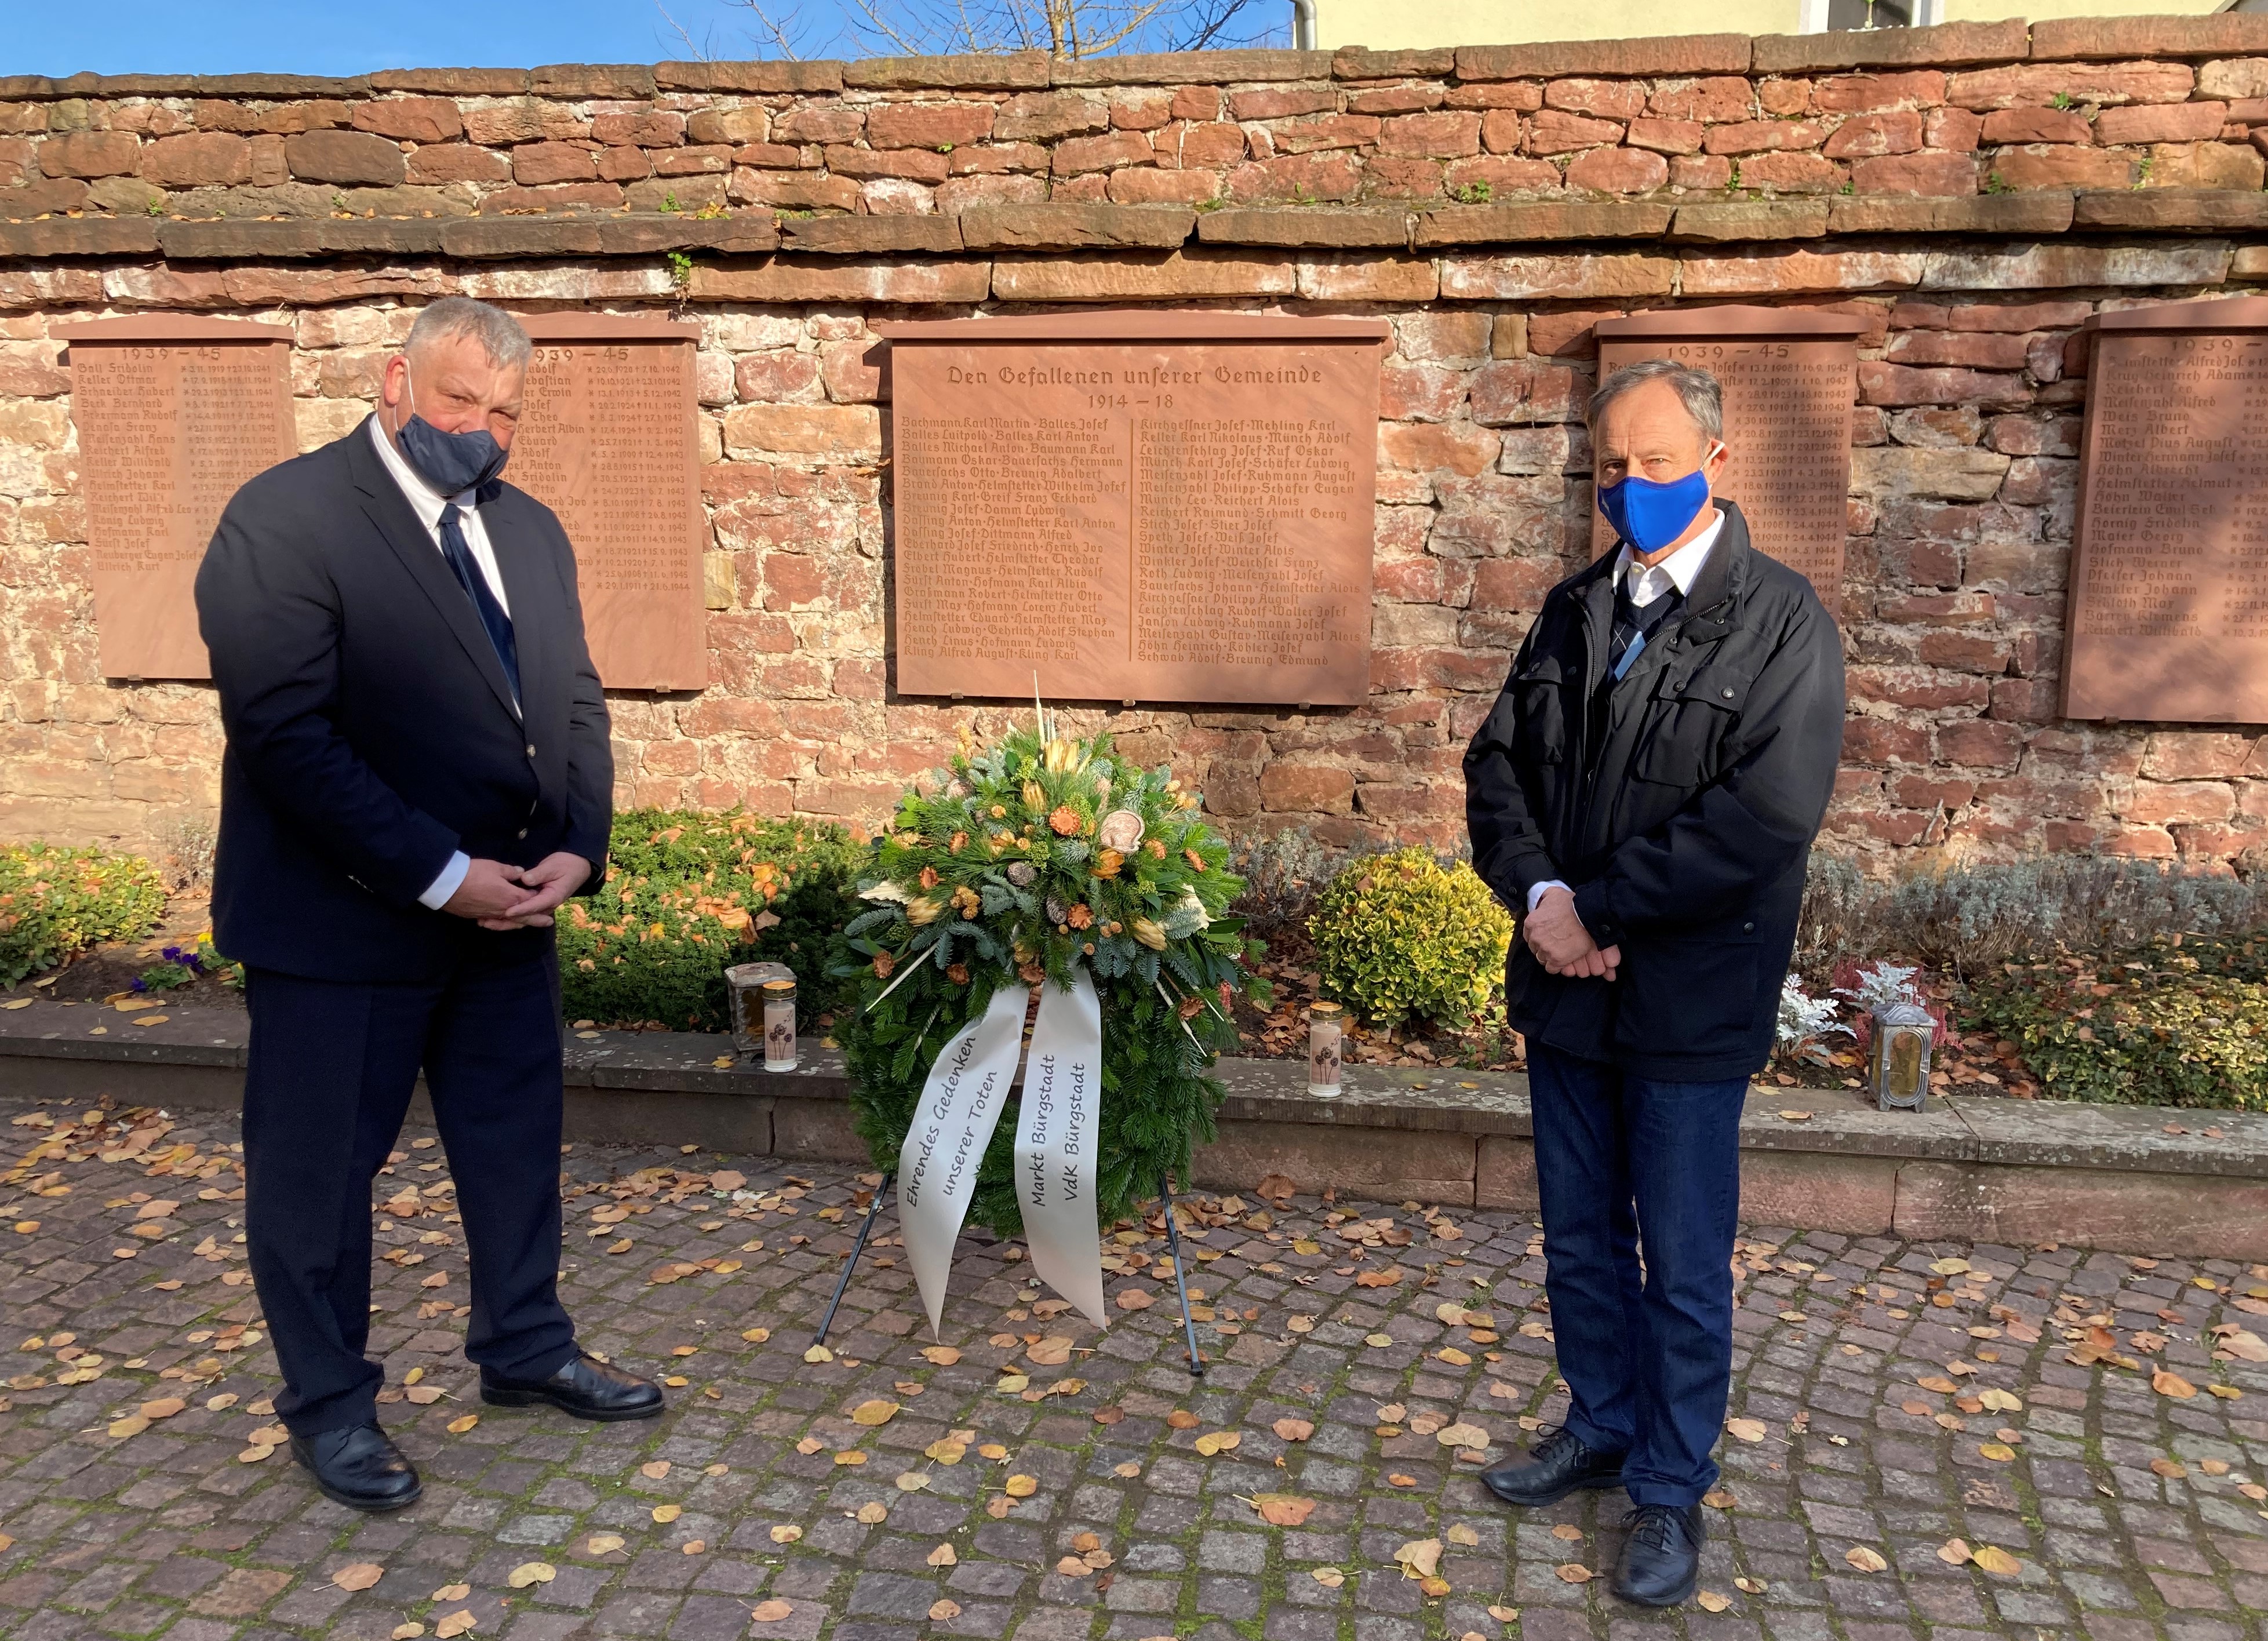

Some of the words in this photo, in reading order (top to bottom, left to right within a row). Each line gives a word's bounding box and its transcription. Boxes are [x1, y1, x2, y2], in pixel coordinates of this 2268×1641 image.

[122, 348, 169, 360] 1939
[198, 347, 221, 360] 45
[536, 349, 574, 362] 939
[603, 347, 629, 361] 45
[1668, 346, 1723, 358] 1939
[1759, 344, 1789, 358] 45
[78, 363, 102, 373] Gall
[526, 363, 556, 374] udolf
[2207, 369, 2245, 380] Adam
[78, 375, 110, 385] Keller
[117, 374, 156, 384] Ottmar
[946, 365, 987, 385] Den
[998, 366, 1113, 388] Gefallenen
[1215, 365, 1322, 384] Gemeinde
[138, 387, 174, 397] Hubert
[540, 387, 571, 396] Erwin
[113, 398, 162, 409] Bernhard
[1089, 394, 1128, 409] 1914
[1156, 394, 1173, 408] 18
[530, 411, 558, 423] Theo
[963, 417, 987, 428] Karl
[990, 417, 1029, 428] Martin
[558, 424, 584, 434] Albin
[1251, 420, 1304, 433] Mehling
[1308, 420, 1335, 431] Karl
[2146, 424, 2189, 435] Albert
[519, 435, 557, 446] Eduard
[902, 429, 939, 440] Balles
[942, 430, 987, 442] Luitpold
[996, 430, 1033, 441] Balles
[1037, 431, 1061, 441] Karl
[1066, 431, 1099, 442] Anton
[1140, 431, 1177, 442] Keller
[1181, 432, 1206, 442] Karl
[1210, 432, 1262, 443] Nikolaus
[1269, 432, 1311, 445] Münch
[1317, 432, 1350, 444] Adolf
[902, 441, 939, 452] Balles
[944, 442, 987, 454] Michael
[991, 442, 1024, 453] Anton
[1031, 443, 1086, 454] Baumann
[1090, 444, 1115, 454] Karl
[1140, 456, 1182, 469] Münch
[1188, 457, 1213, 468] Karl
[1254, 458, 1300, 470] Schäfer
[1306, 459, 1349, 471] Ludwig
[522, 471, 567, 482] Fridolin
[904, 490, 947, 503] Breunig
[953, 492, 976, 501] Karl
[981, 492, 1011, 503] Greif
[1015, 492, 1047, 504] Franz
[1052, 493, 1097, 505] Eckhard
[1140, 494, 1181, 506] Münch
[1187, 495, 1206, 505] Leo
[1214, 495, 1262, 507] Reichert
[1268, 496, 1299, 506] Alois
[904, 503, 947, 515] Breunig
[985, 504, 1021, 515] Damm
[1025, 505, 1066, 517] Ludwig
[1140, 506, 1188, 518] Reichert
[1193, 507, 1248, 517] Raimund
[1257, 507, 1304, 520] Schmitt
[1310, 507, 1346, 521] Georg
[147, 527, 169, 537] Karl
[1140, 543, 1179, 554] Winter
[1219, 544, 1260, 555] Winter
[1264, 544, 1294, 555] Alois
[935, 576, 969, 586] Anton
[973, 577, 1024, 589] Hofmann
[1029, 578, 1053, 588] Karl
[1057, 578, 1086, 588] Albin
[904, 623, 937, 635] Hench
[942, 624, 981, 636] Ludwig
[988, 624, 1034, 637] Gehrlich
[1038, 625, 1065, 638] Adolf
[1068, 626, 1115, 639] Stephan
[904, 634, 937, 646] Hench
[942, 636, 973, 646] Linus
[981, 636, 1031, 649] Hofmann
[1036, 637, 1075, 650] Ludwig
[904, 646, 934, 658] Kling
[940, 646, 971, 658] Alfred
[1019, 649, 1048, 661] Kling
[1055, 650, 1078, 660] Karl
[1138, 651, 1184, 663] Schwab
[1189, 652, 1219, 665] Adolf
[1226, 653, 1272, 667] Breunig
[1279, 654, 1328, 665] Edmund
[1032, 1054, 1054, 1144] Bürgstadt
[1065, 1063, 1085, 1155] Bürgstadt
[907, 1126, 939, 1207] Ehrendes
[933, 1037, 976, 1120] Gedenken
[943, 1126, 974, 1196] unserer
[968, 1071, 997, 1119] Toten
[1029, 1152, 1045, 1206] Markt
[1062, 1165, 1078, 1200] VdK
